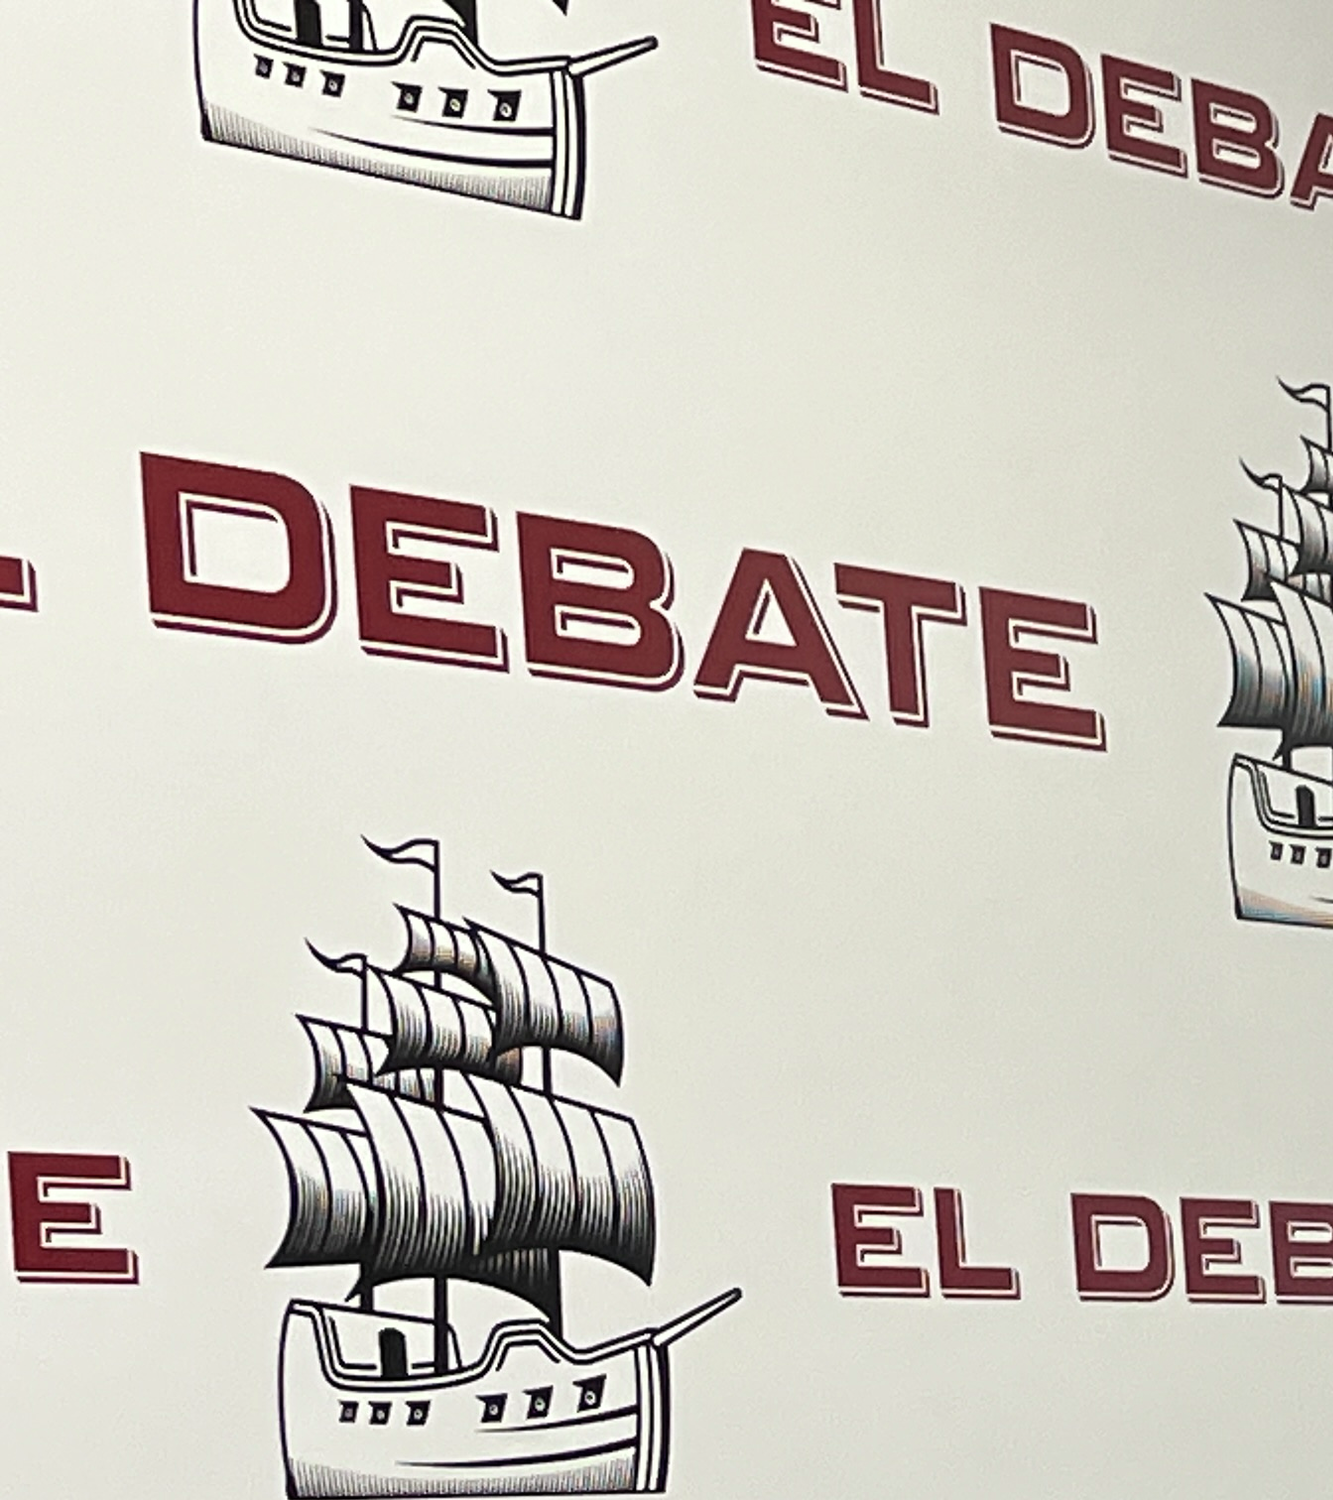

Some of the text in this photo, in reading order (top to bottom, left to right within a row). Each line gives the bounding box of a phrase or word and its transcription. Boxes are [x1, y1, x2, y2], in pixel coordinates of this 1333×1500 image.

[751, 0, 940, 115] EL
[140, 452, 1107, 750] DEBATE
[833, 1184, 1021, 1298] EL
